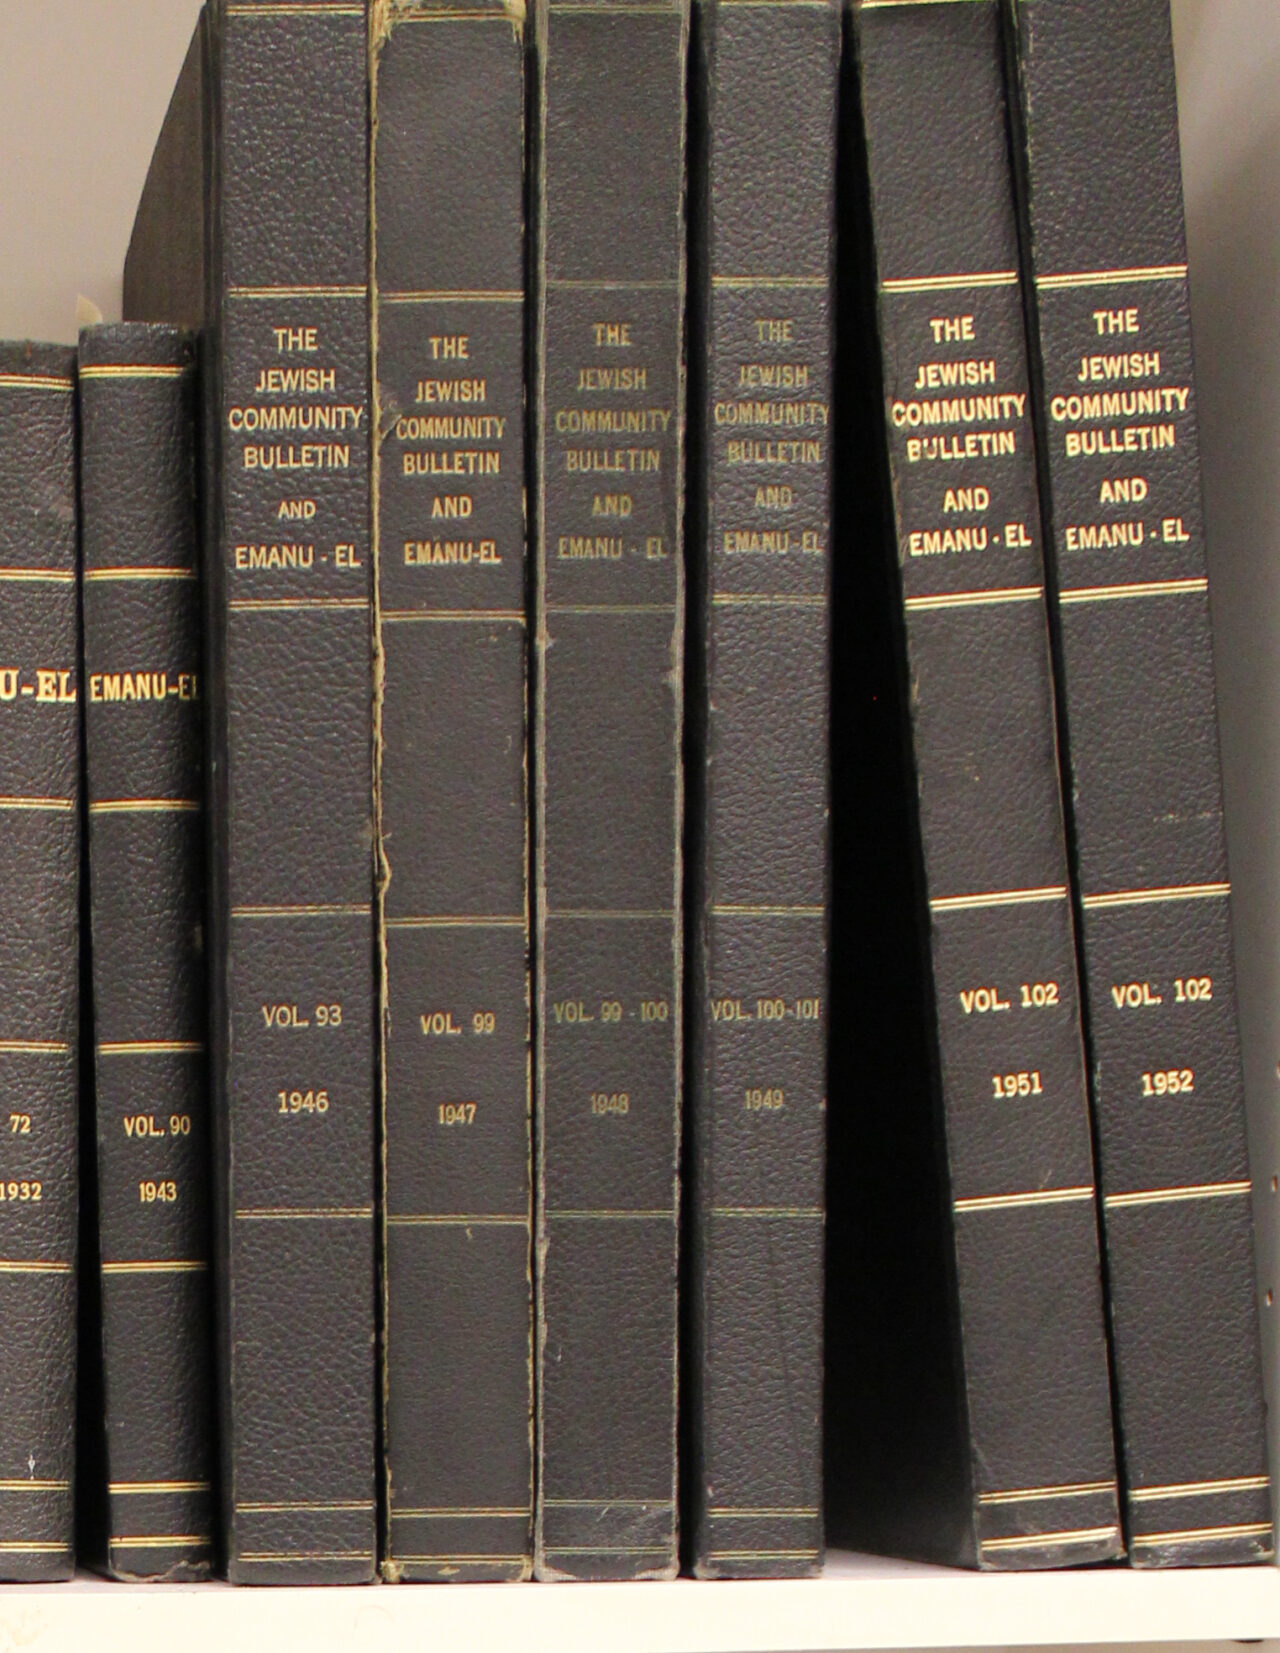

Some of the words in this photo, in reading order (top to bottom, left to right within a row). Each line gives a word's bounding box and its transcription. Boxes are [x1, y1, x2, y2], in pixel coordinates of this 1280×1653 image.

[754, 318, 795, 343] THE
[929, 314, 976, 343] THE
[1092, 307, 1140, 335] THE
[272, 326, 319, 351] THE
[428, 335, 469, 360] THE
[592, 322, 633, 347] THE
[576, 367, 647, 391] JEWISH
[738, 363, 809, 388] JEWISH
[914, 359, 996, 389] JEWISH
[1077, 351, 1161, 382] JEWISH
[254, 367, 336, 393] JEWISH
[413, 378, 487, 403] JEWISH
[713, 401, 830, 426] COMMUNITY
[891, 393, 1026, 427] COMMUNITY
[1049, 386, 1191, 422] COMMUNITY
[227, 404, 364, 432] COMMUNITY
[395, 414, 506, 440] COMMUNITY
[554, 408, 672, 433] COMMUNITY
[726, 439, 821, 465] BULLETIN
[906, 430, 1016, 462] BULLETIN
[1064, 423, 1176, 457] BULLETIN
[242, 443, 350, 470] BULLETIN
[402, 450, 501, 476] BULLETIN
[565, 447, 661, 473] BULLETIN
[754, 485, 793, 509] AND
[942, 485, 990, 513] AND
[1099, 476, 1149, 504] AND
[276, 498, 317, 521] AND
[430, 494, 473, 519] AND
[592, 493, 633, 518] AND
[403, 539, 503, 566] EMANU-EL
[723, 529, 824, 555] EMANU-EL
[959, 986, 1011, 1014] VOL.
[1019, 980, 1060, 1008] 102
[1111, 981, 1163, 1009] VOL.
[1173, 975, 1213, 1003] 102
[261, 1003, 310, 1029] VOL.
[314, 1003, 343, 1027] 93
[419, 1011, 463, 1035] VOL.
[471, 1010, 496, 1034] 99
[553, 1000, 595, 1024] VOL.
[710, 998, 753, 1021] VOL.
[991, 1070, 1044, 1099] 1951
[1140, 1067, 1195, 1097] 1952
[276, 1089, 330, 1115] 1946
[590, 1092, 630, 1115] 1948
[745, 1088, 785, 1111] 1949
[7, 1112, 31, 1135] 72
[122, 1114, 166, 1139] VOL.
[168, 1113, 191, 1137] 90
[436, 1101, 477, 1126] 1947
[137, 1180, 177, 1203] 1943
